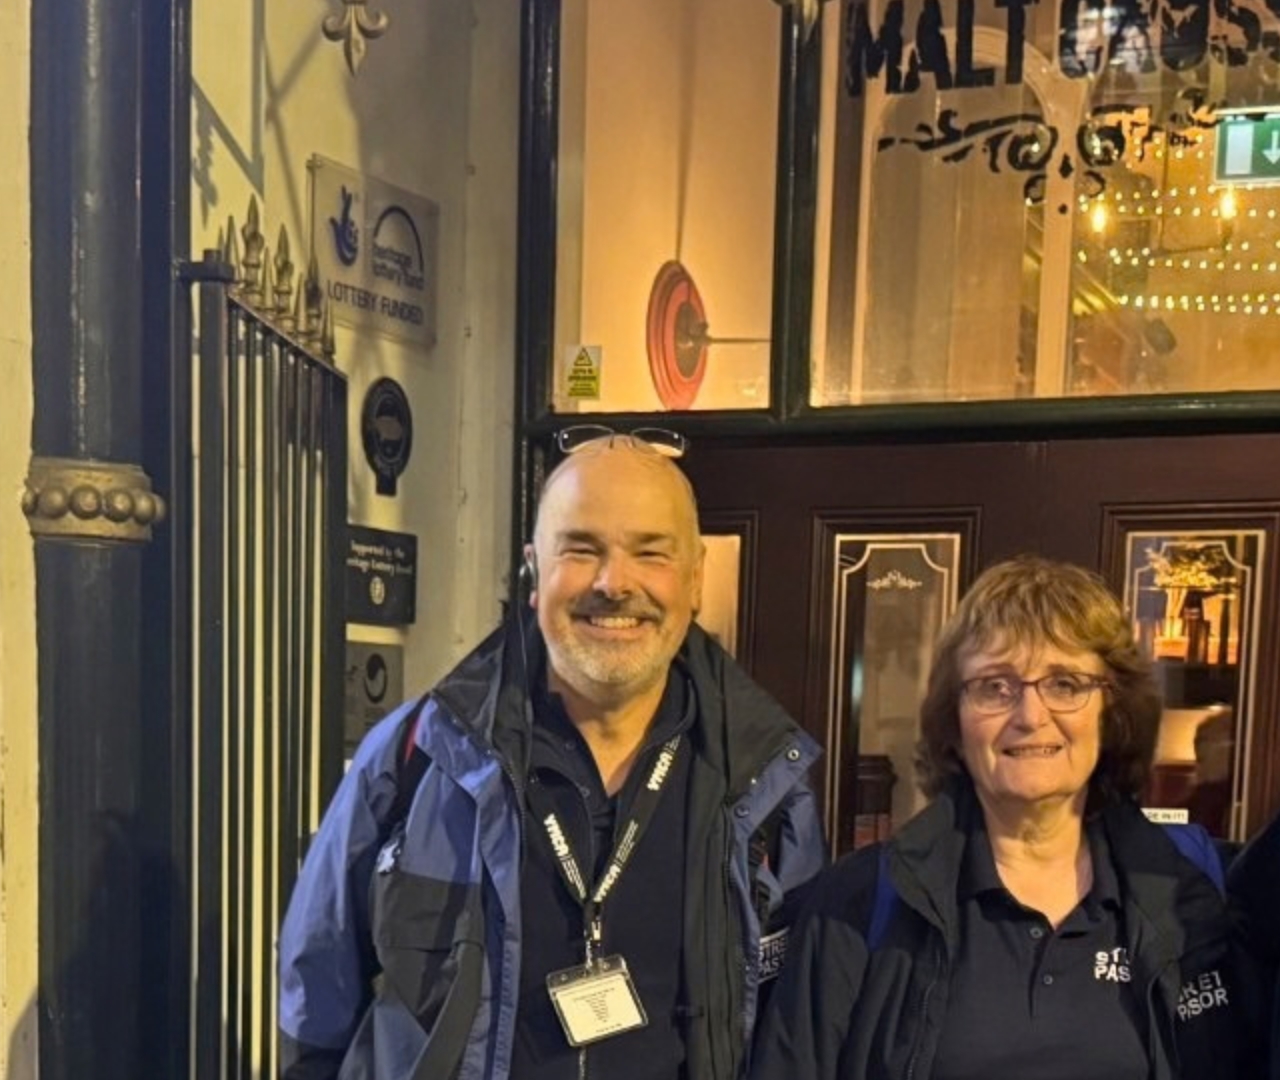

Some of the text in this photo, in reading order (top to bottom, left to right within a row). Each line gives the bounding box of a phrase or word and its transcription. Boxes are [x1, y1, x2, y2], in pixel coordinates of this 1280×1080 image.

[846, 0, 1039, 96] MALT
[327, 279, 425, 326] LOTTERY FUNDED
[646, 751, 674, 791] YMCA
[543, 813, 571, 857] YMCA
[593, 864, 623, 902] YMCA
